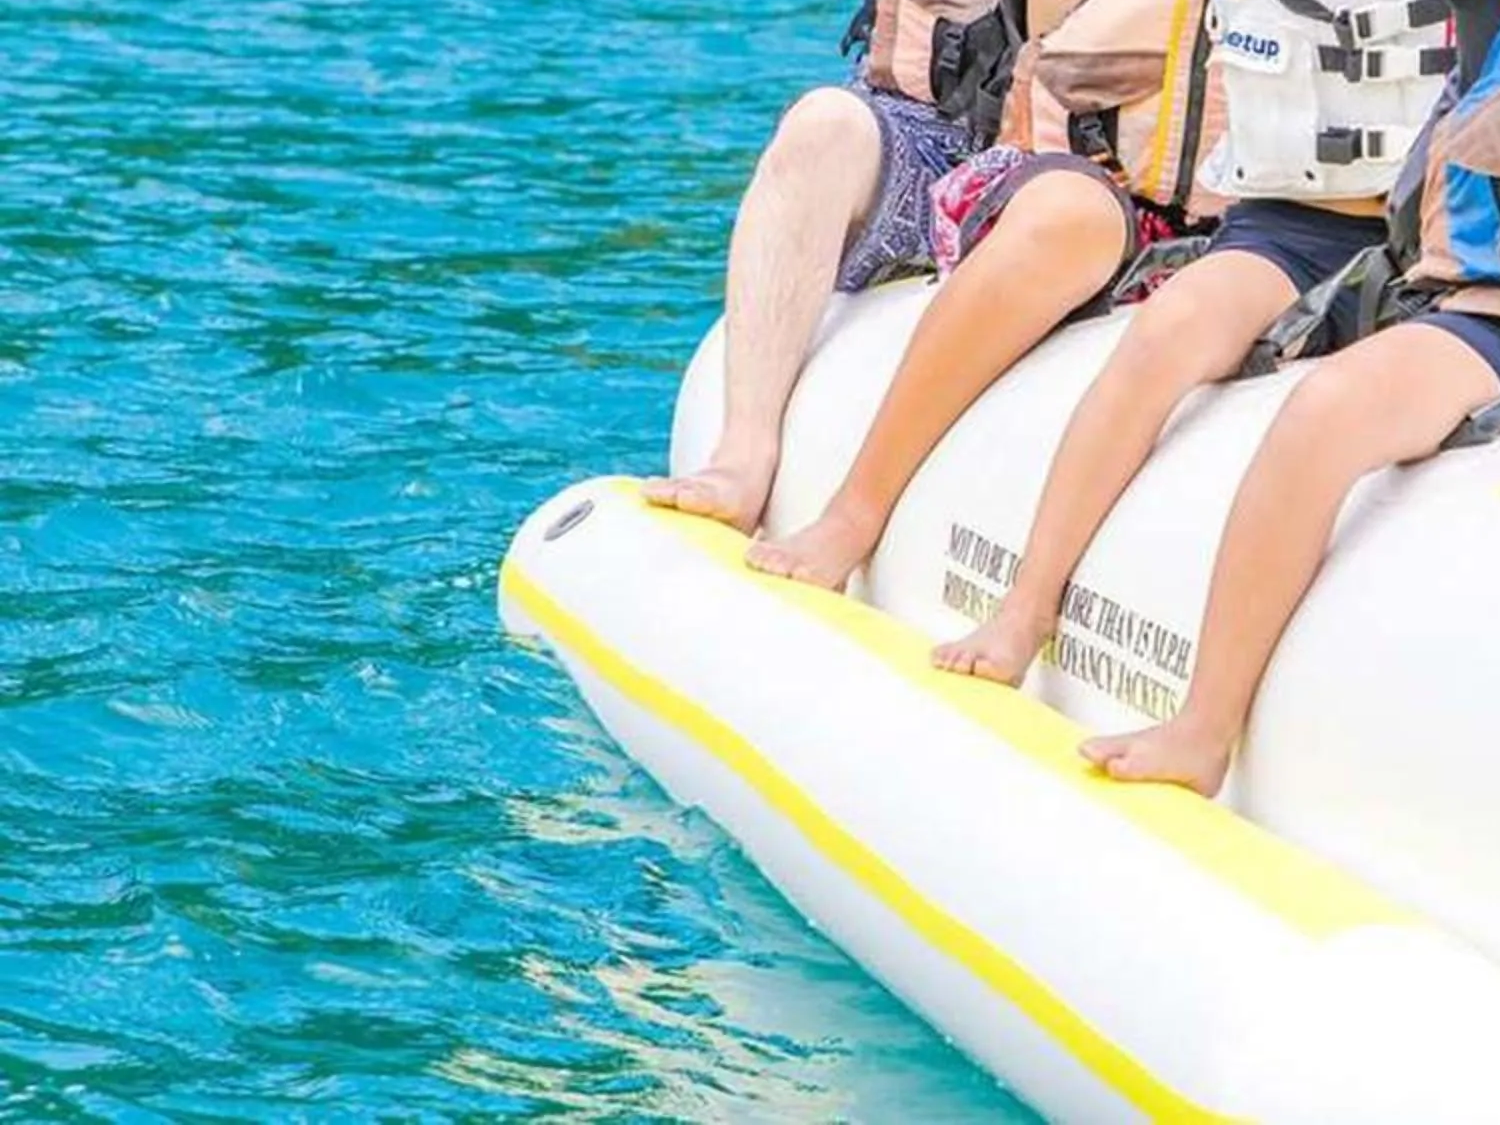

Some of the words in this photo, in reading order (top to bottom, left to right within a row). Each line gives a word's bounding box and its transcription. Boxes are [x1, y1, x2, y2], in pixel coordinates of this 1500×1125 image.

[946, 523, 975, 566] NOT
[970, 535, 991, 574] TO
[985, 543, 1009, 584] BE
[1059, 579, 1099, 630] ORE
[1094, 596, 1138, 650] THAN
